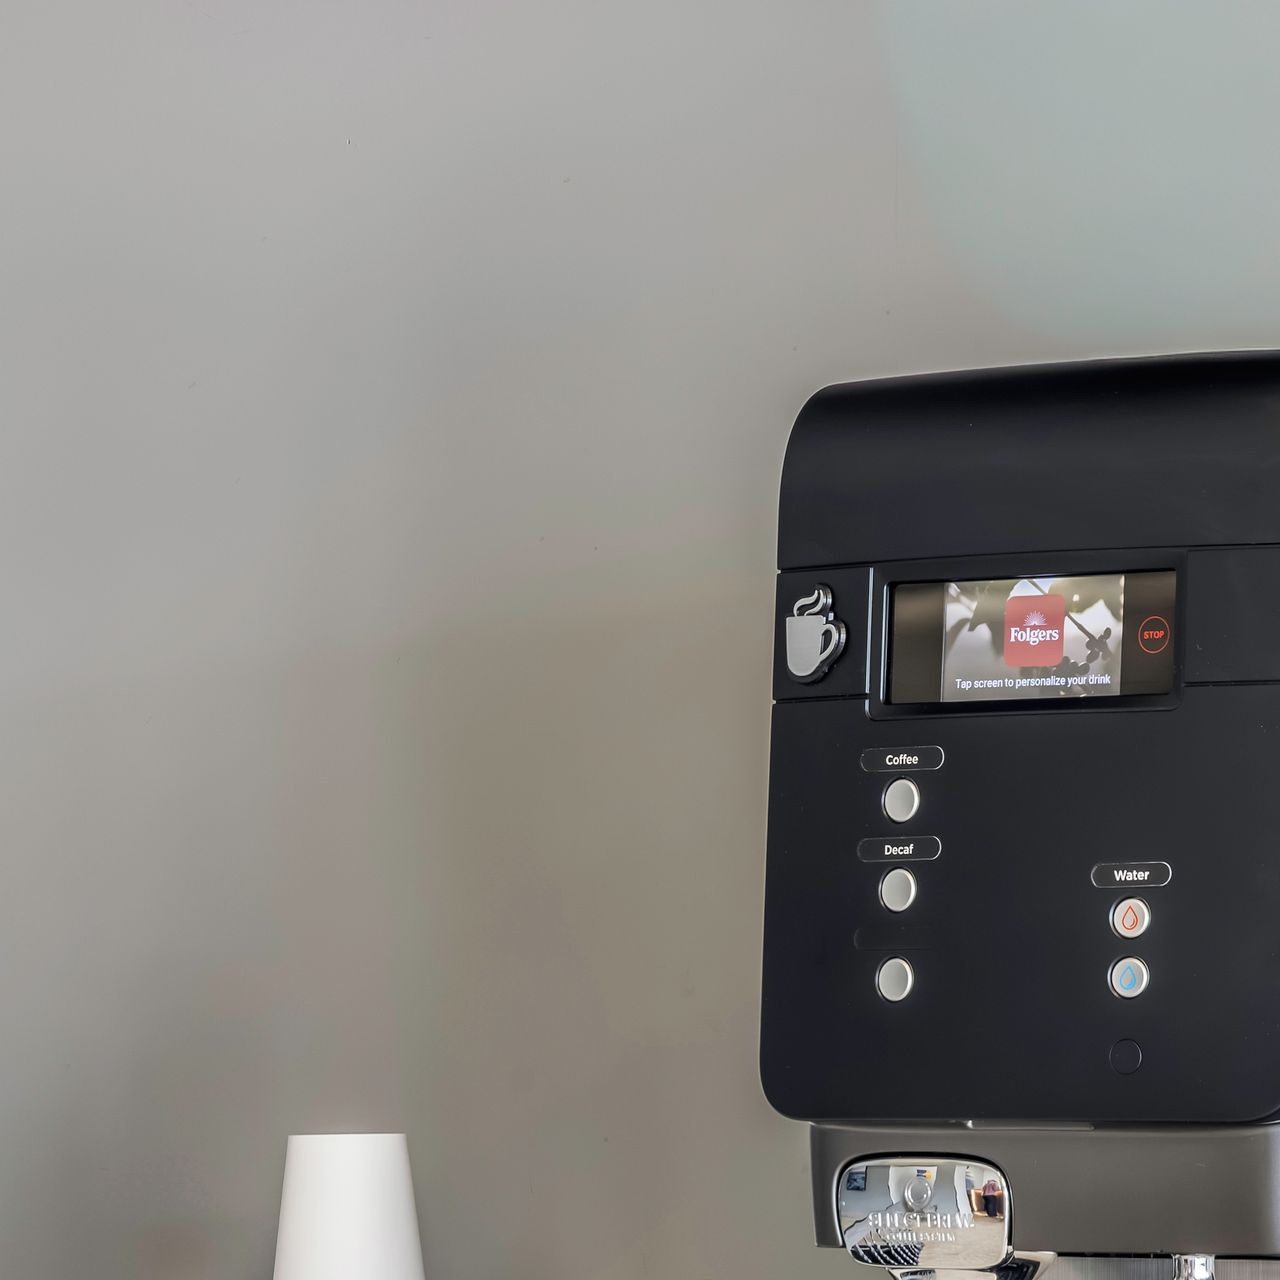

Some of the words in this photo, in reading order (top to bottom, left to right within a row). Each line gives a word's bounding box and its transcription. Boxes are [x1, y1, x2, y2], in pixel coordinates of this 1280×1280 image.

[1009, 627, 1059, 645] Folgers
[1143, 630, 1165, 640] STOP
[955, 678, 971, 690] Tap
[973, 678, 1003, 689] screen
[1004, 677, 1014, 688] to
[1015, 675, 1066, 690] personalize
[1067, 676, 1087, 688] your
[1088, 673, 1111, 685] drink
[885, 754, 919, 766] Coffee
[884, 843, 914, 855] Decaf
[1113, 869, 1150, 881] Water
